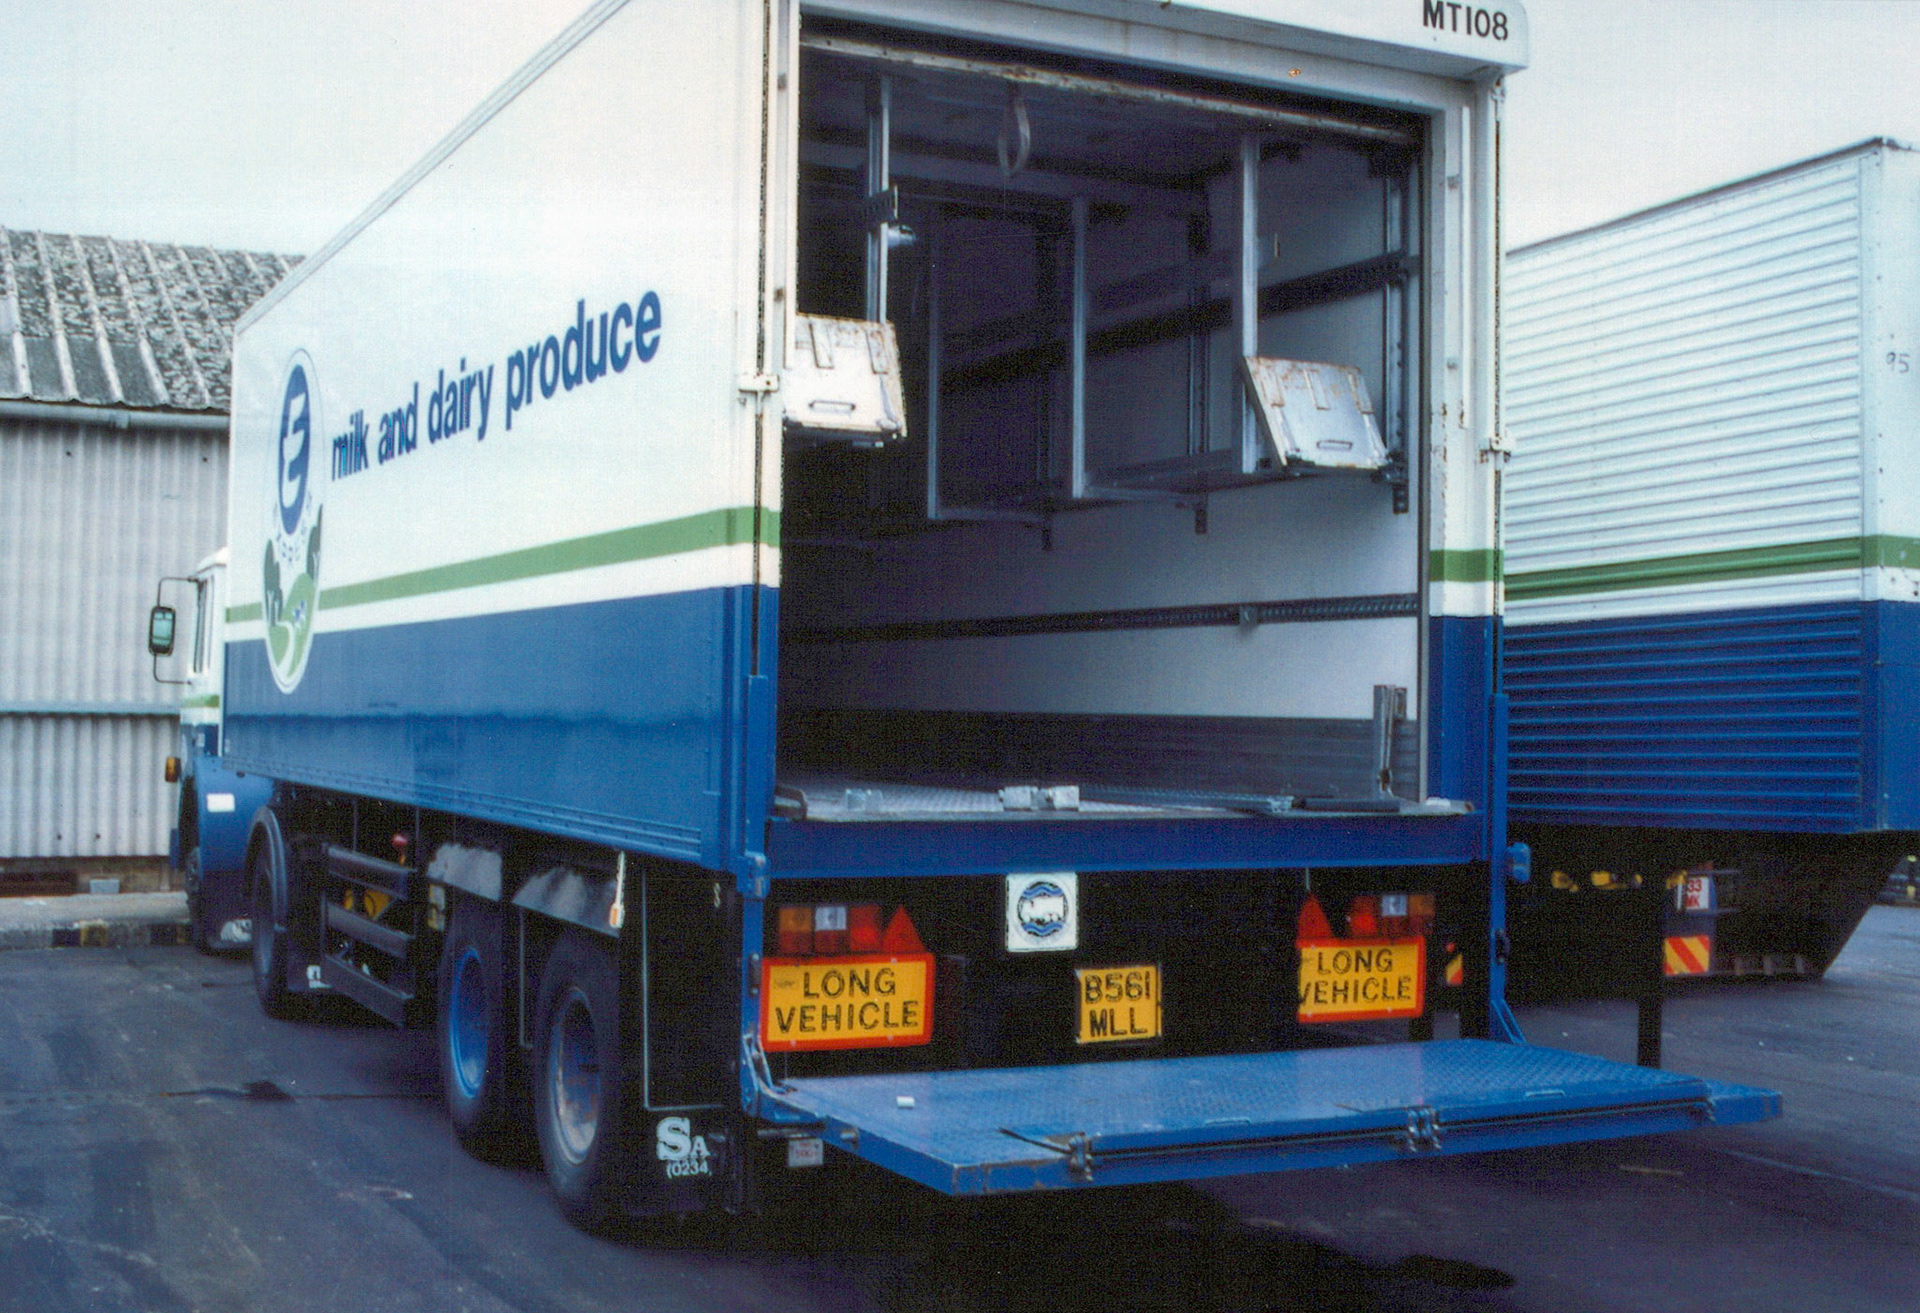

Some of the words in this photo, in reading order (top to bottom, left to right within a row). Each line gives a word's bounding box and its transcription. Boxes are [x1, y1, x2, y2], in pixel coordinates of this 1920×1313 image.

[1423, 0, 1508, 41] MT108
[332, 409, 369, 481] milk
[378, 381, 419, 466] and
[428, 357, 494, 442] dairy
[506, 290, 661, 431] produce
[1317, 948, 1394, 976] LONG
[803, 967, 896, 999] LONG
[1084, 970, 1151, 1004] B561
[1299, 976, 1412, 1006] VEHICLE
[775, 1000, 919, 1034] VEHICLE
[1088, 1007, 1148, 1038] MLL
